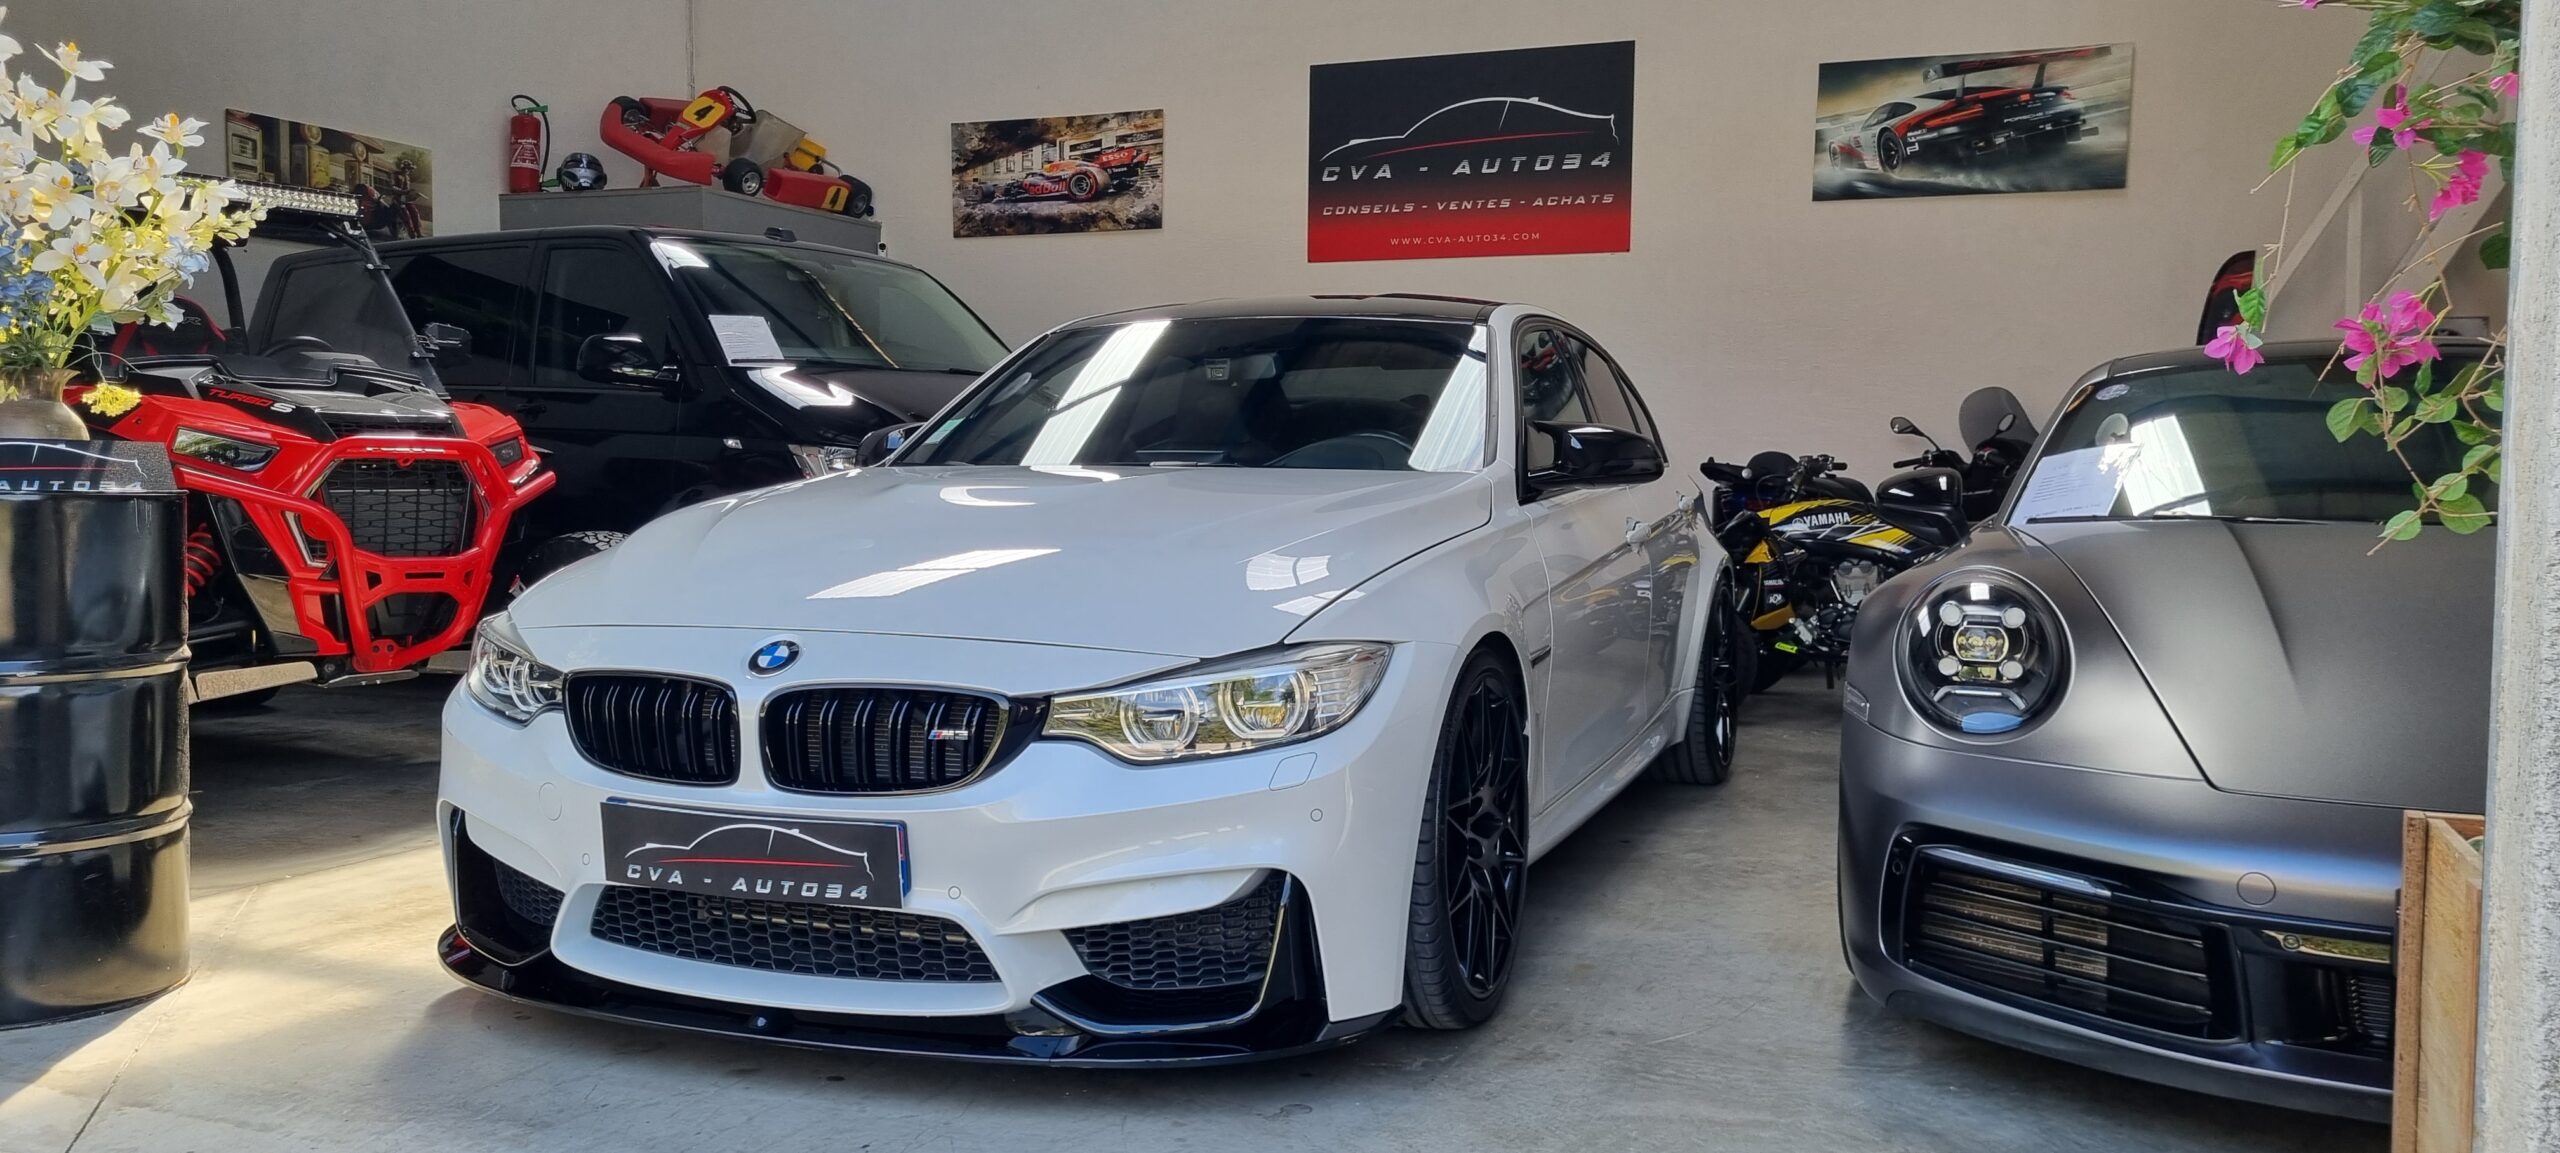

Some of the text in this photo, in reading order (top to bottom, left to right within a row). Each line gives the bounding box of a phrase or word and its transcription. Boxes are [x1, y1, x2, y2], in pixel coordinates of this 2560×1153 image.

[694, 105, 714, 121] 4
[1102, 151, 1128, 162] ESSO
[1322, 164, 1391, 182] CVA
[1452, 152, 1611, 175] AUTO34
[829, 188, 841, 208] 4
[1322, 203, 1414, 216] CONSEILS
[1437, 198, 1511, 210] VENTES
[1532, 194, 1614, 206] ACHATS
[1390, 233, 1540, 245] WWW.CVA-AUTO34.COM
[209, 387, 296, 413] TURBO S
[1803, 512, 1850, 526] YAMAHA
[627, 863, 682, 885] CVA
[731, 877, 868, 900] AUTO34
